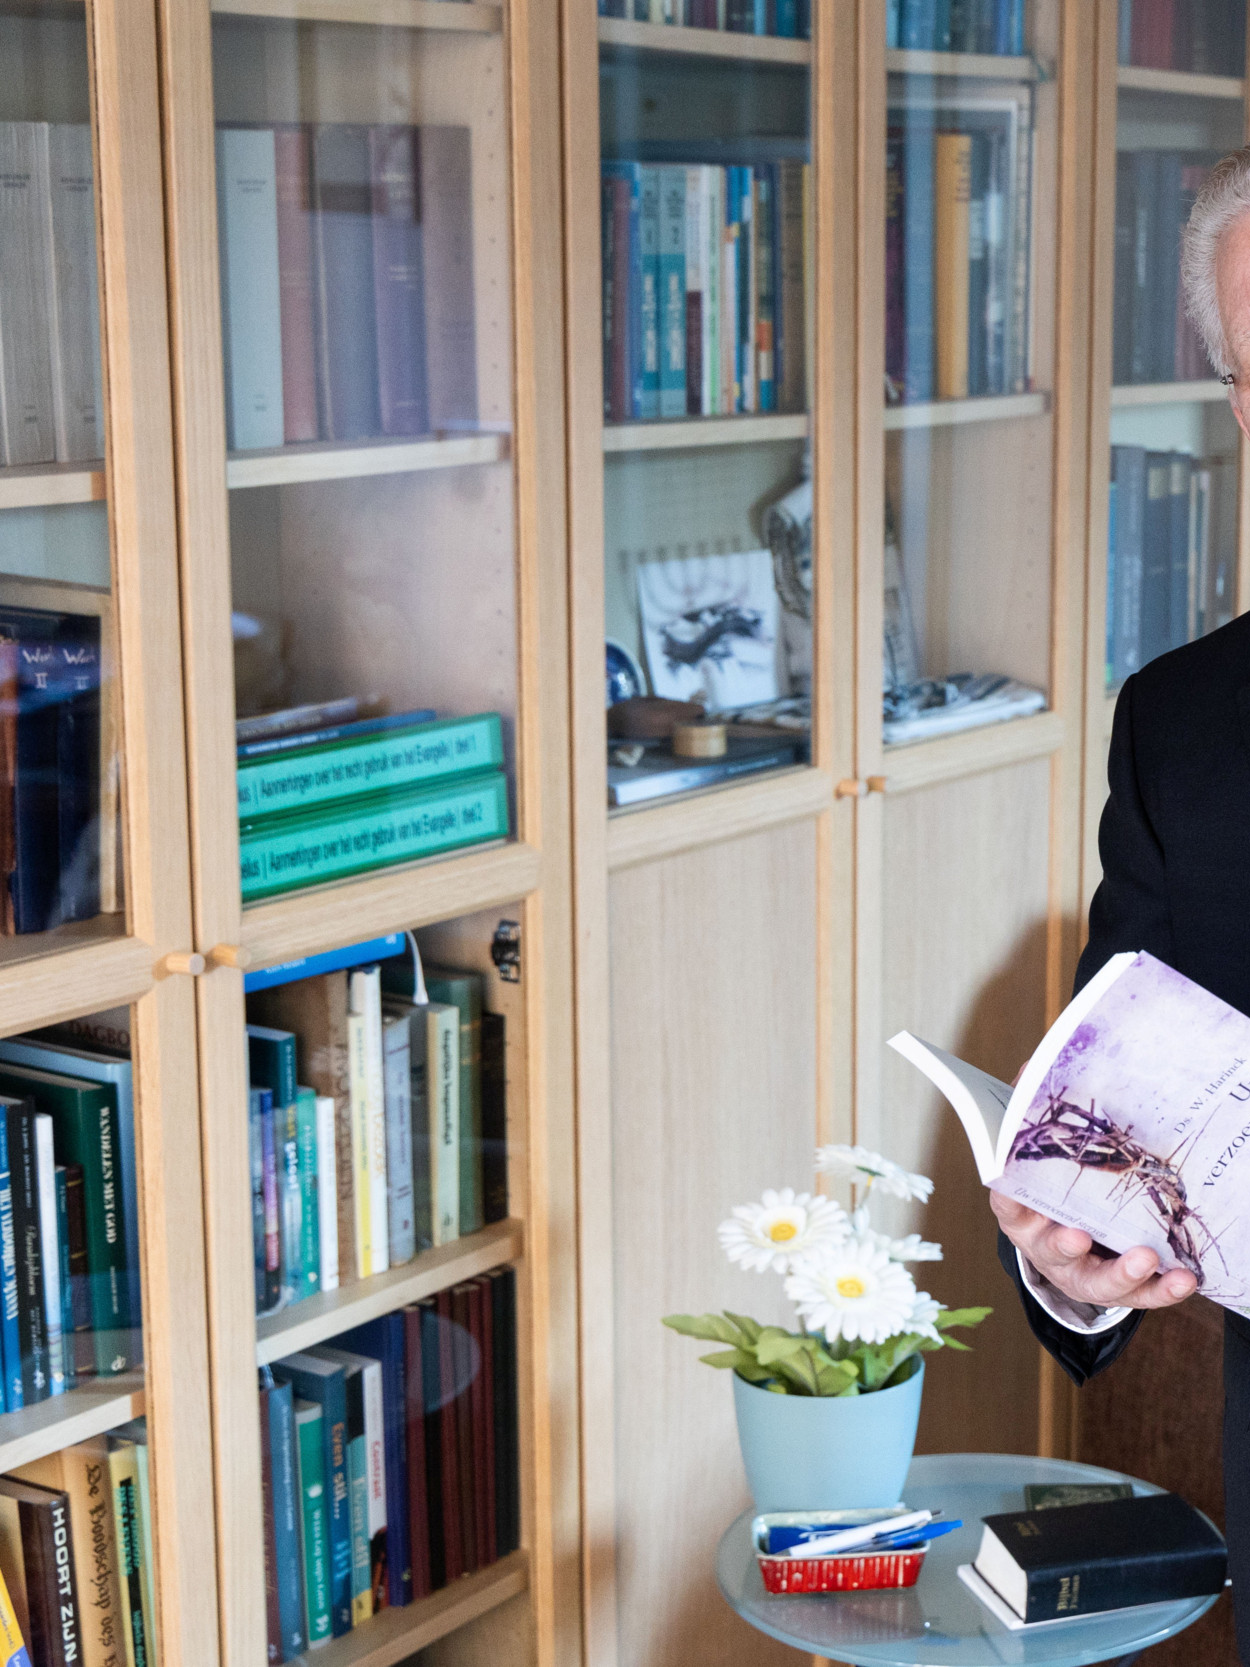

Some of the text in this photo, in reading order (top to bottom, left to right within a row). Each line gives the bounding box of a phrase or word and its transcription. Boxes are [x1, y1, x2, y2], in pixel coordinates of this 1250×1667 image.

[261, 772, 313, 797] Aanmerkingen
[315, 769, 330, 786] over
[331, 763, 345, 782] het
[364, 755, 388, 781] gebruik
[416, 740, 449, 764] Evangelie
[270, 844, 322, 870] Aanmerkingen
[323, 840, 339, 859] over
[339, 834, 352, 853] het
[372, 824, 396, 853] gebruik
[423, 808, 456, 835] Evangelie
[1174, 1057, 1246, 1134] Ds. W. Harinck
[100, 1106, 118, 1243] WANDELEN MET GOD
[1014, 1187, 1107, 1239] Uw verzoenend sterven
[332, 1422, 345, 1467] Even
[52, 1507, 78, 1663] HOORT ZIJN
[1057, 1576, 1071, 1611] Bijbel
